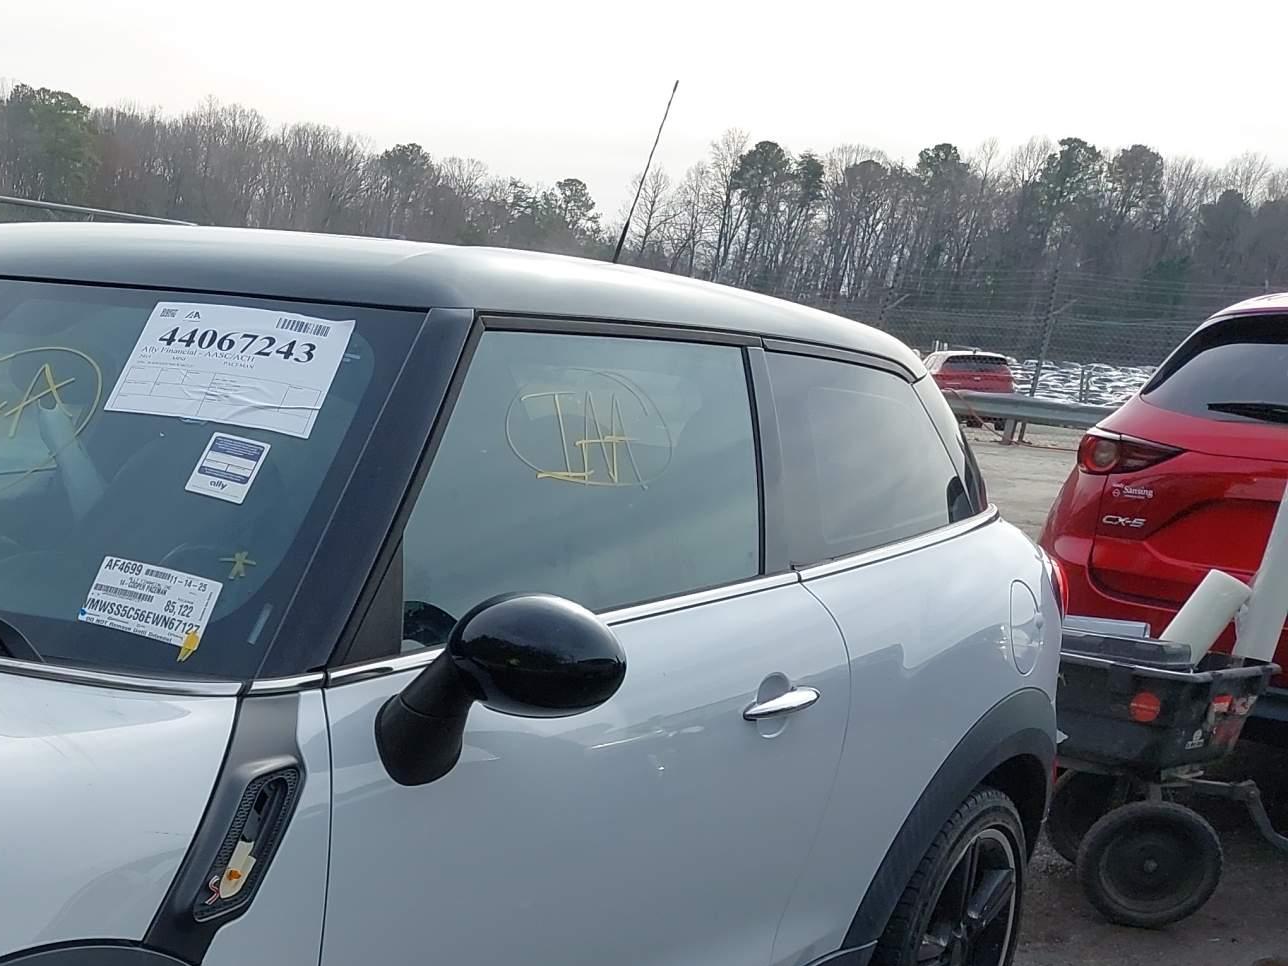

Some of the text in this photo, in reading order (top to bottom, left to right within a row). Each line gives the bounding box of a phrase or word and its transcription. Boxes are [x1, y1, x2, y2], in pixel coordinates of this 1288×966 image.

[159, 326, 317, 364] 44067243
[209, 479, 227, 490] ally
[1102, 514, 1147, 528] CX-5
[104, 558, 144, 577] AF4699
[169, 575, 208, 593] 11-14-25
[163, 599, 194, 618] 85,122
